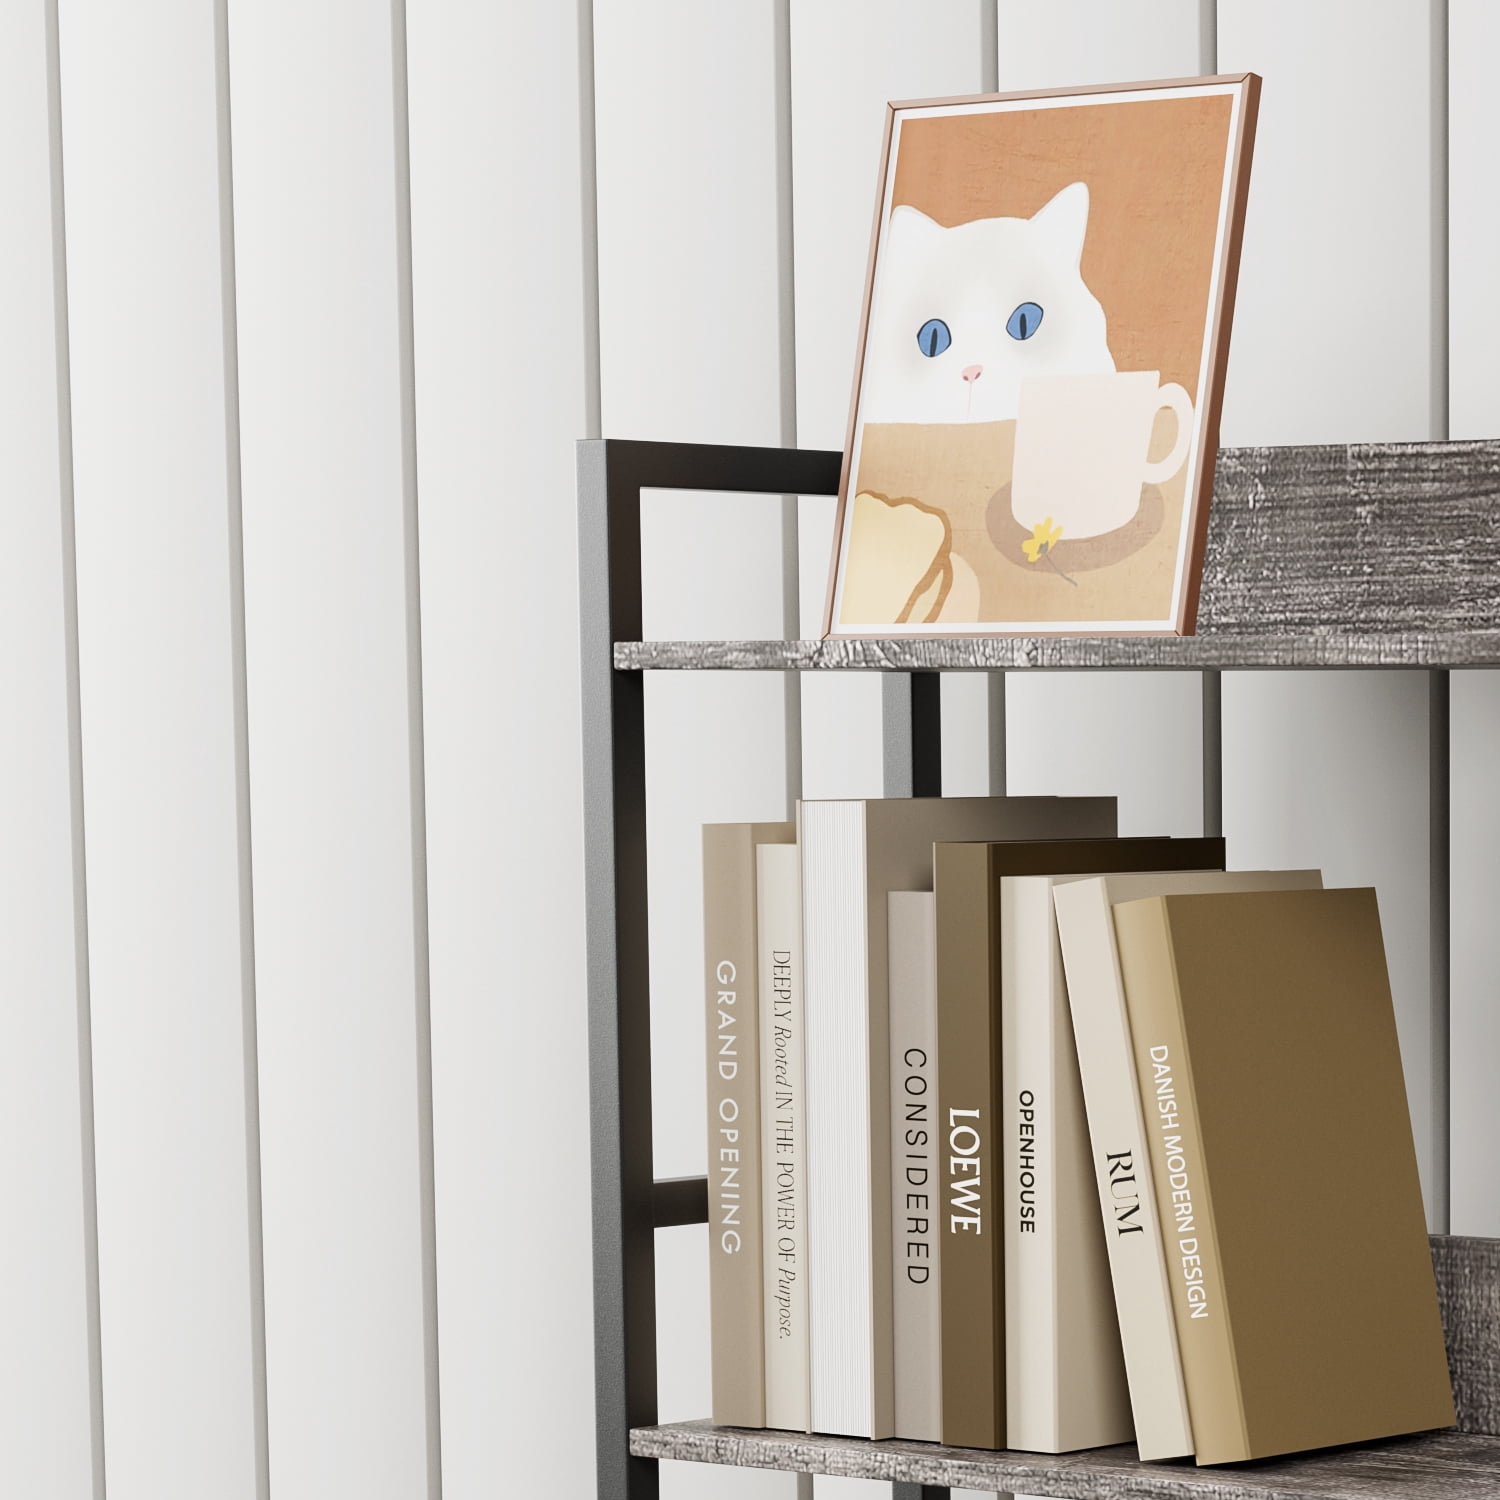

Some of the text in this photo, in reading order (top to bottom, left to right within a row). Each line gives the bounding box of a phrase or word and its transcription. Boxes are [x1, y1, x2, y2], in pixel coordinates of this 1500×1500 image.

[716, 960, 741, 1255] GRAND OPENING
[773, 950, 796, 1339] DEEPLY Rooted IN THE POWER OF Purpose.
[904, 1048, 929, 1284] CONSIDERED
[949, 1107, 981, 1235] LOEWE
[1019, 1090, 1035, 1233] OPENHOUSE
[1106, 1149, 1144, 1238] RUM
[1150, 1045, 1209, 1319] DANISH MODERN DESIGN
